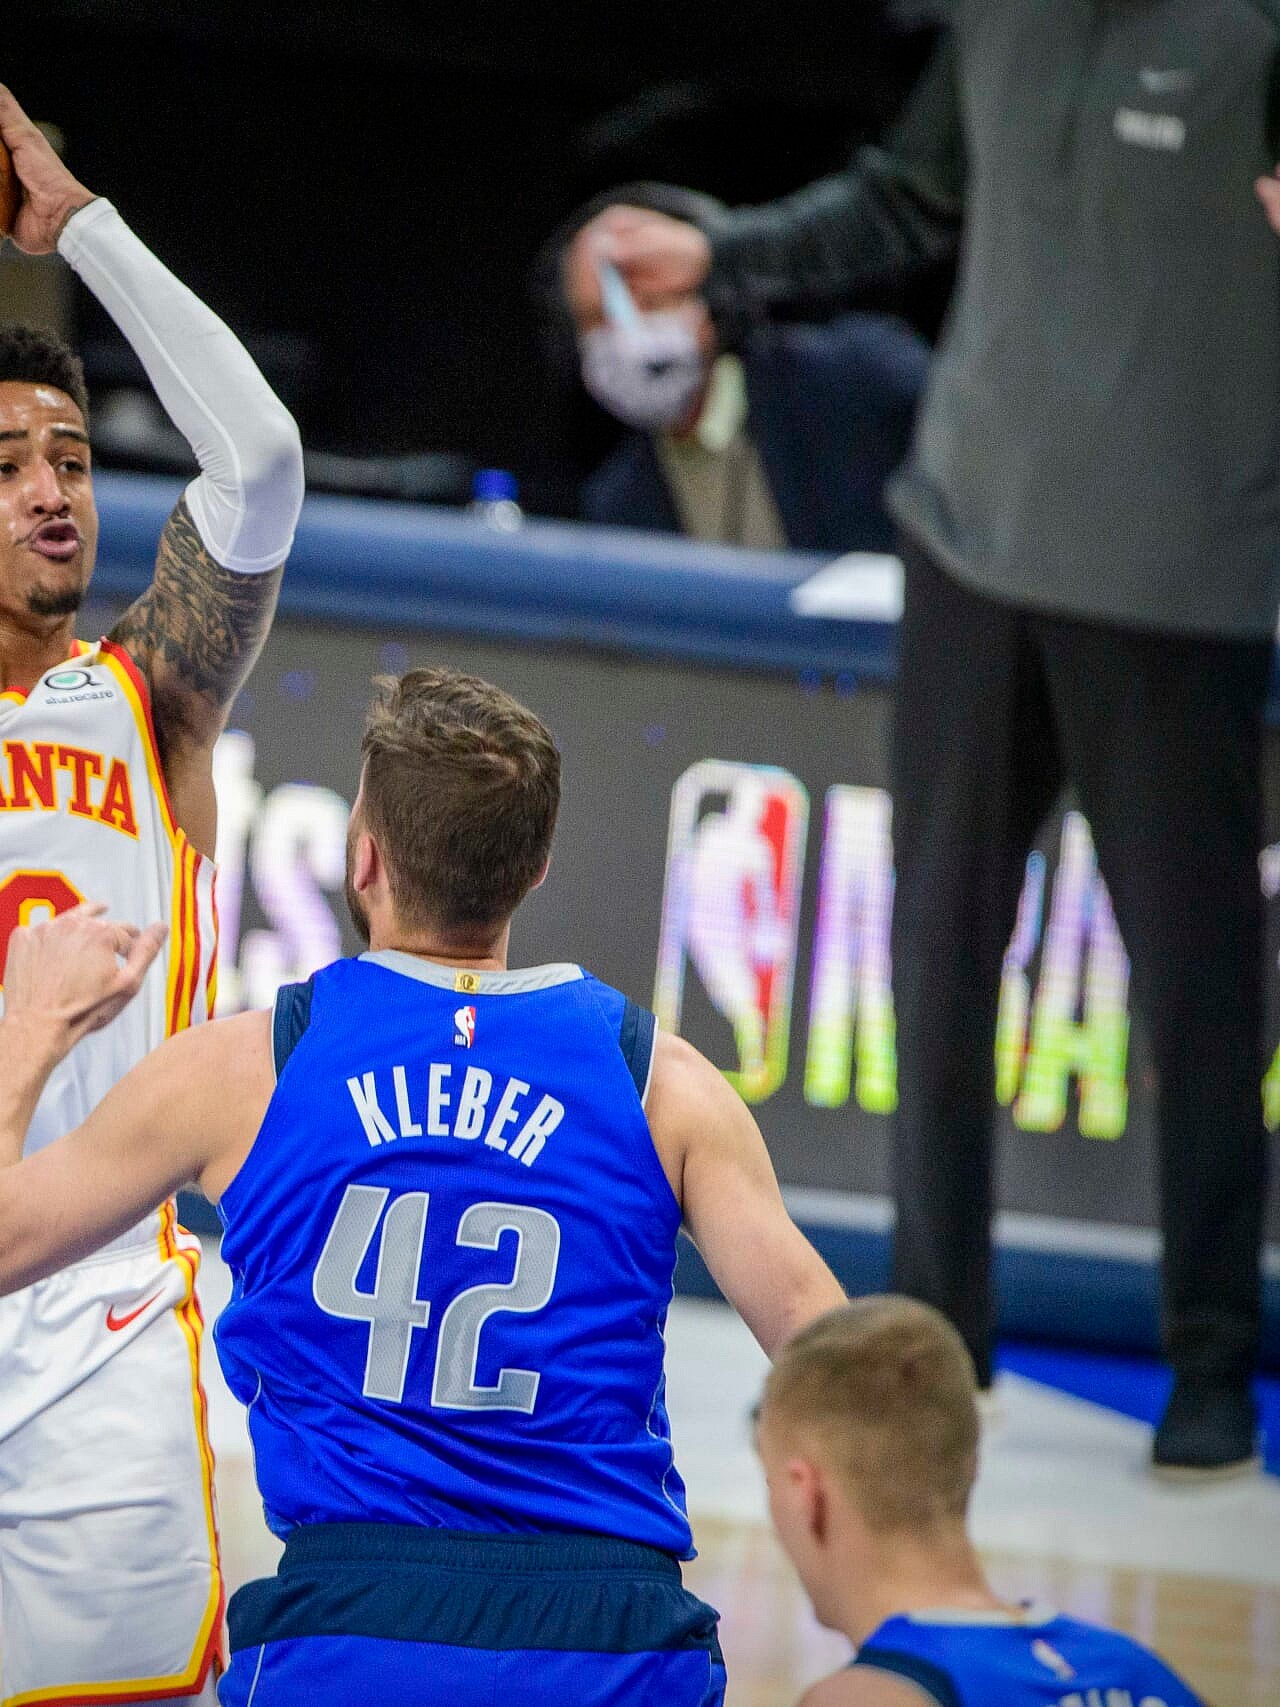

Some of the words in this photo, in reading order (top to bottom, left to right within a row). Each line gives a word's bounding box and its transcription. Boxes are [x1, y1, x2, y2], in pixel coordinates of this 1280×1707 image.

[45, 689, 115, 705] sharecare
[346, 1063, 565, 1167] KLEBER
[312, 1183, 560, 1415] 42
